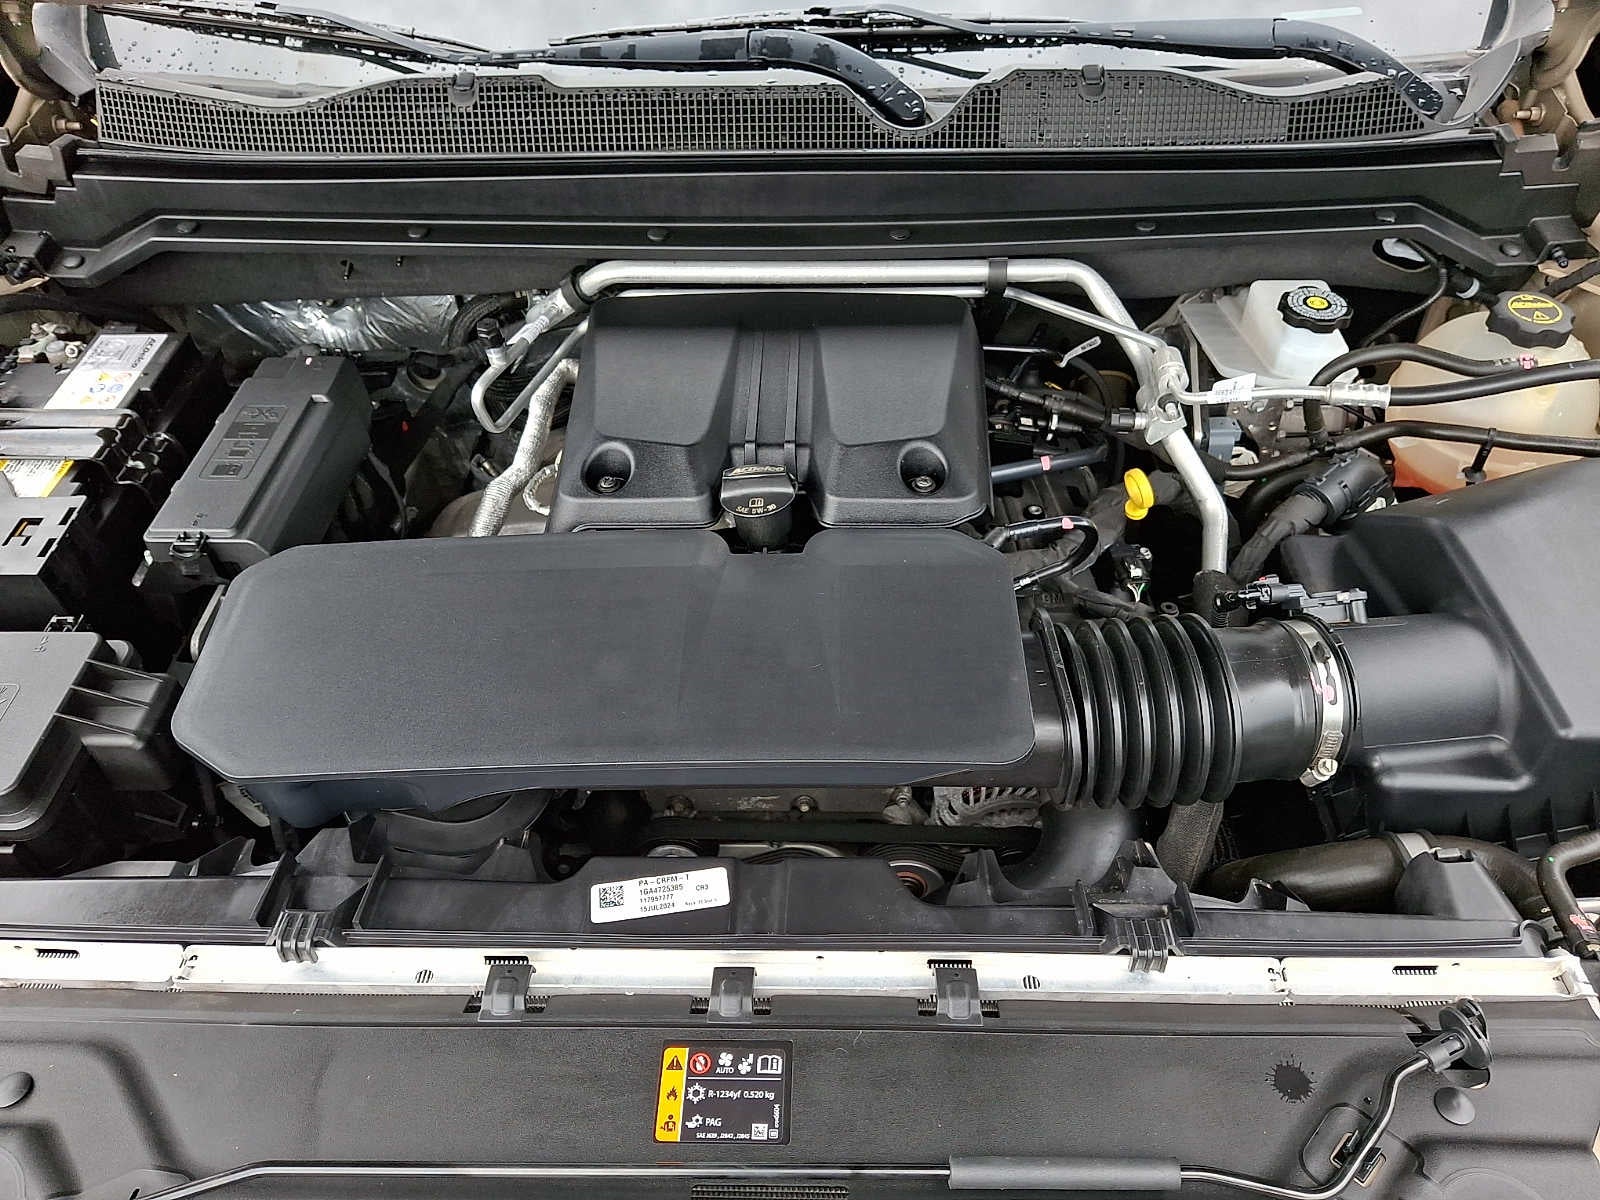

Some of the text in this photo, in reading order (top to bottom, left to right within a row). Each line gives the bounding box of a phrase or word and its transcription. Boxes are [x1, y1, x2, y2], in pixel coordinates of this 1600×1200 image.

[729, 466, 784, 476] ACDelco
[736, 503, 777, 514] SAE 5W-30
[716, 1066, 735, 1074] AUTO
[707, 1090, 775, 1101] R-1234yf 0.520 kg
[705, 1117, 722, 1127] PAG
